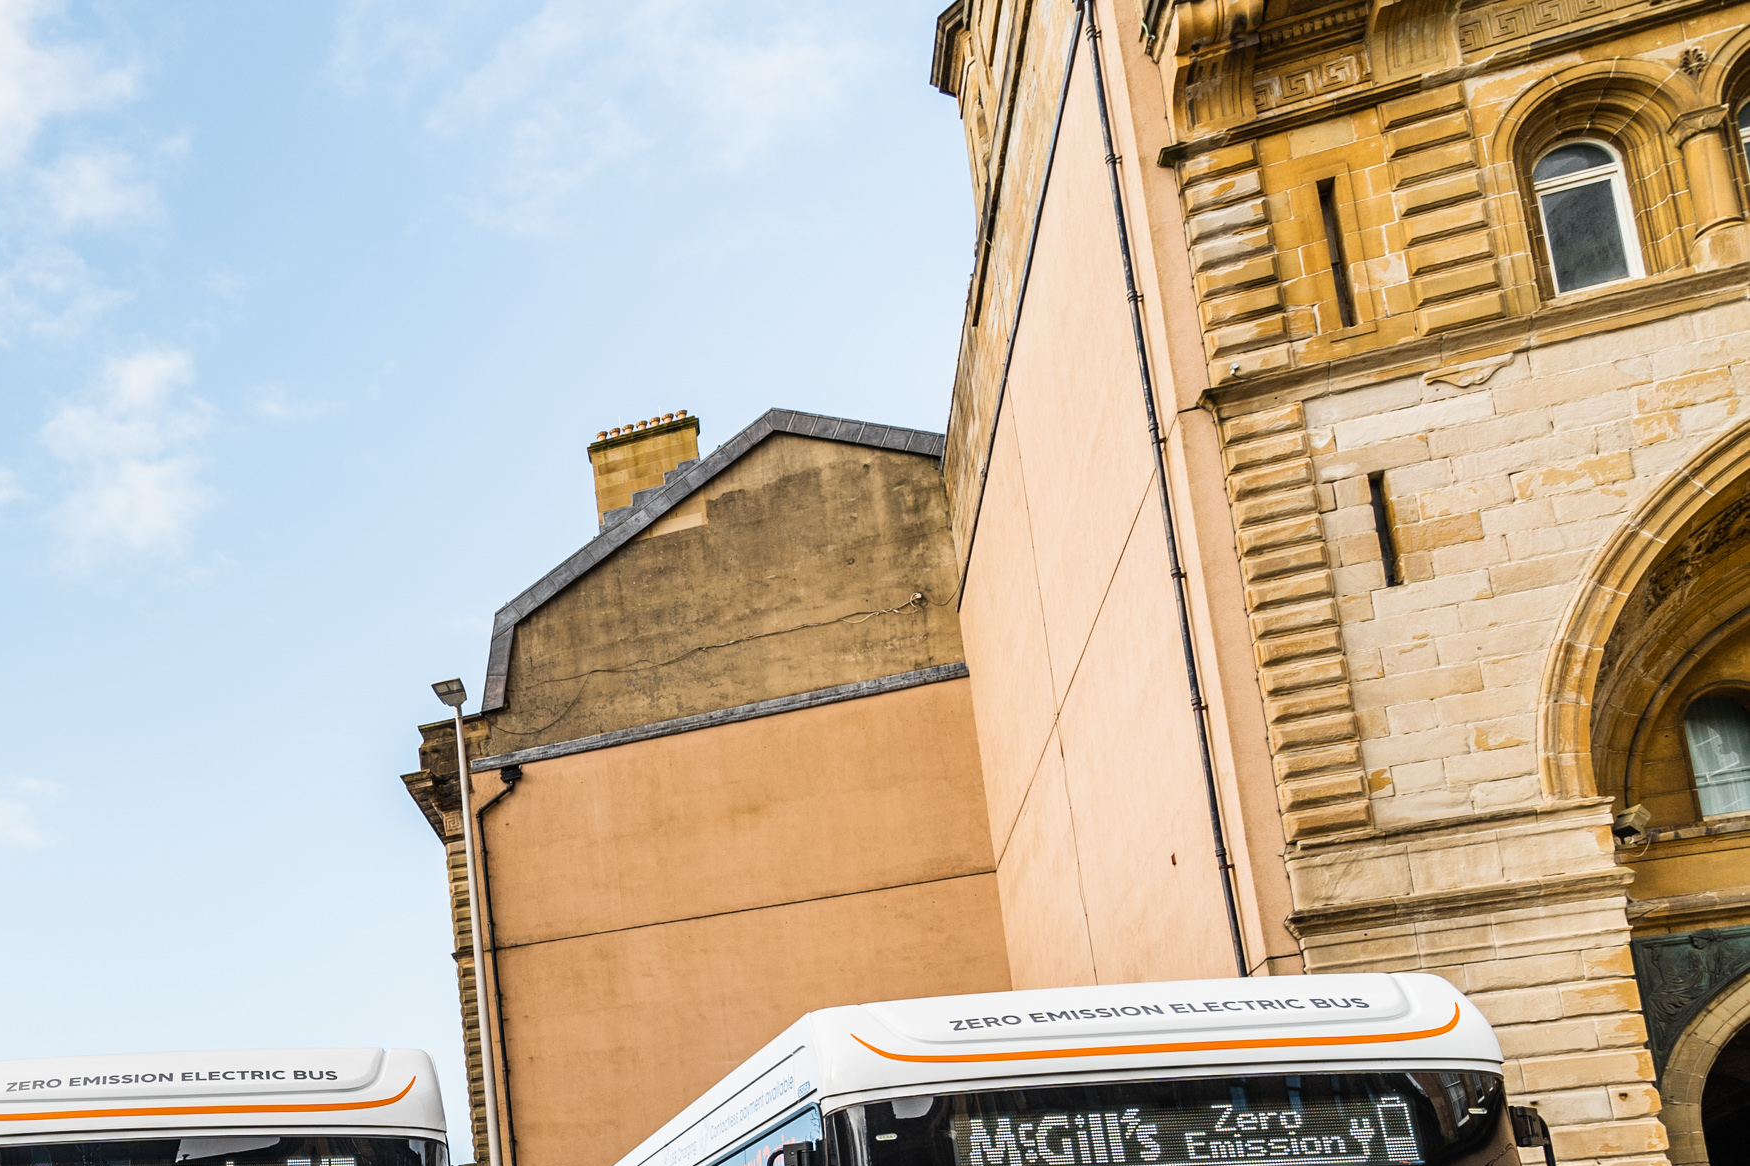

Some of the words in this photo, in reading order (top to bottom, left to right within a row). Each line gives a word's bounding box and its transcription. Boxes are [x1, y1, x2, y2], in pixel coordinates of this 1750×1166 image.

[949, 1013, 1023, 1032] ZERO
[1028, 1004, 1165, 1024] EMISSION
[1169, 998, 1307, 1016] ELECTRIC
[1311, 997, 1371, 1009] BUS
[5, 1077, 63, 1092] ZERO
[68, 1072, 174, 1088] EMISSION
[180, 1070, 286, 1082] ELECTRIC
[293, 1070, 338, 1081] BUS
[739, 1093, 764, 1124] payment
[765, 1075, 794, 1104] available
[1210, 1104, 1302, 1132] Zero
[1185, 1131, 1347, 1161] Emission
